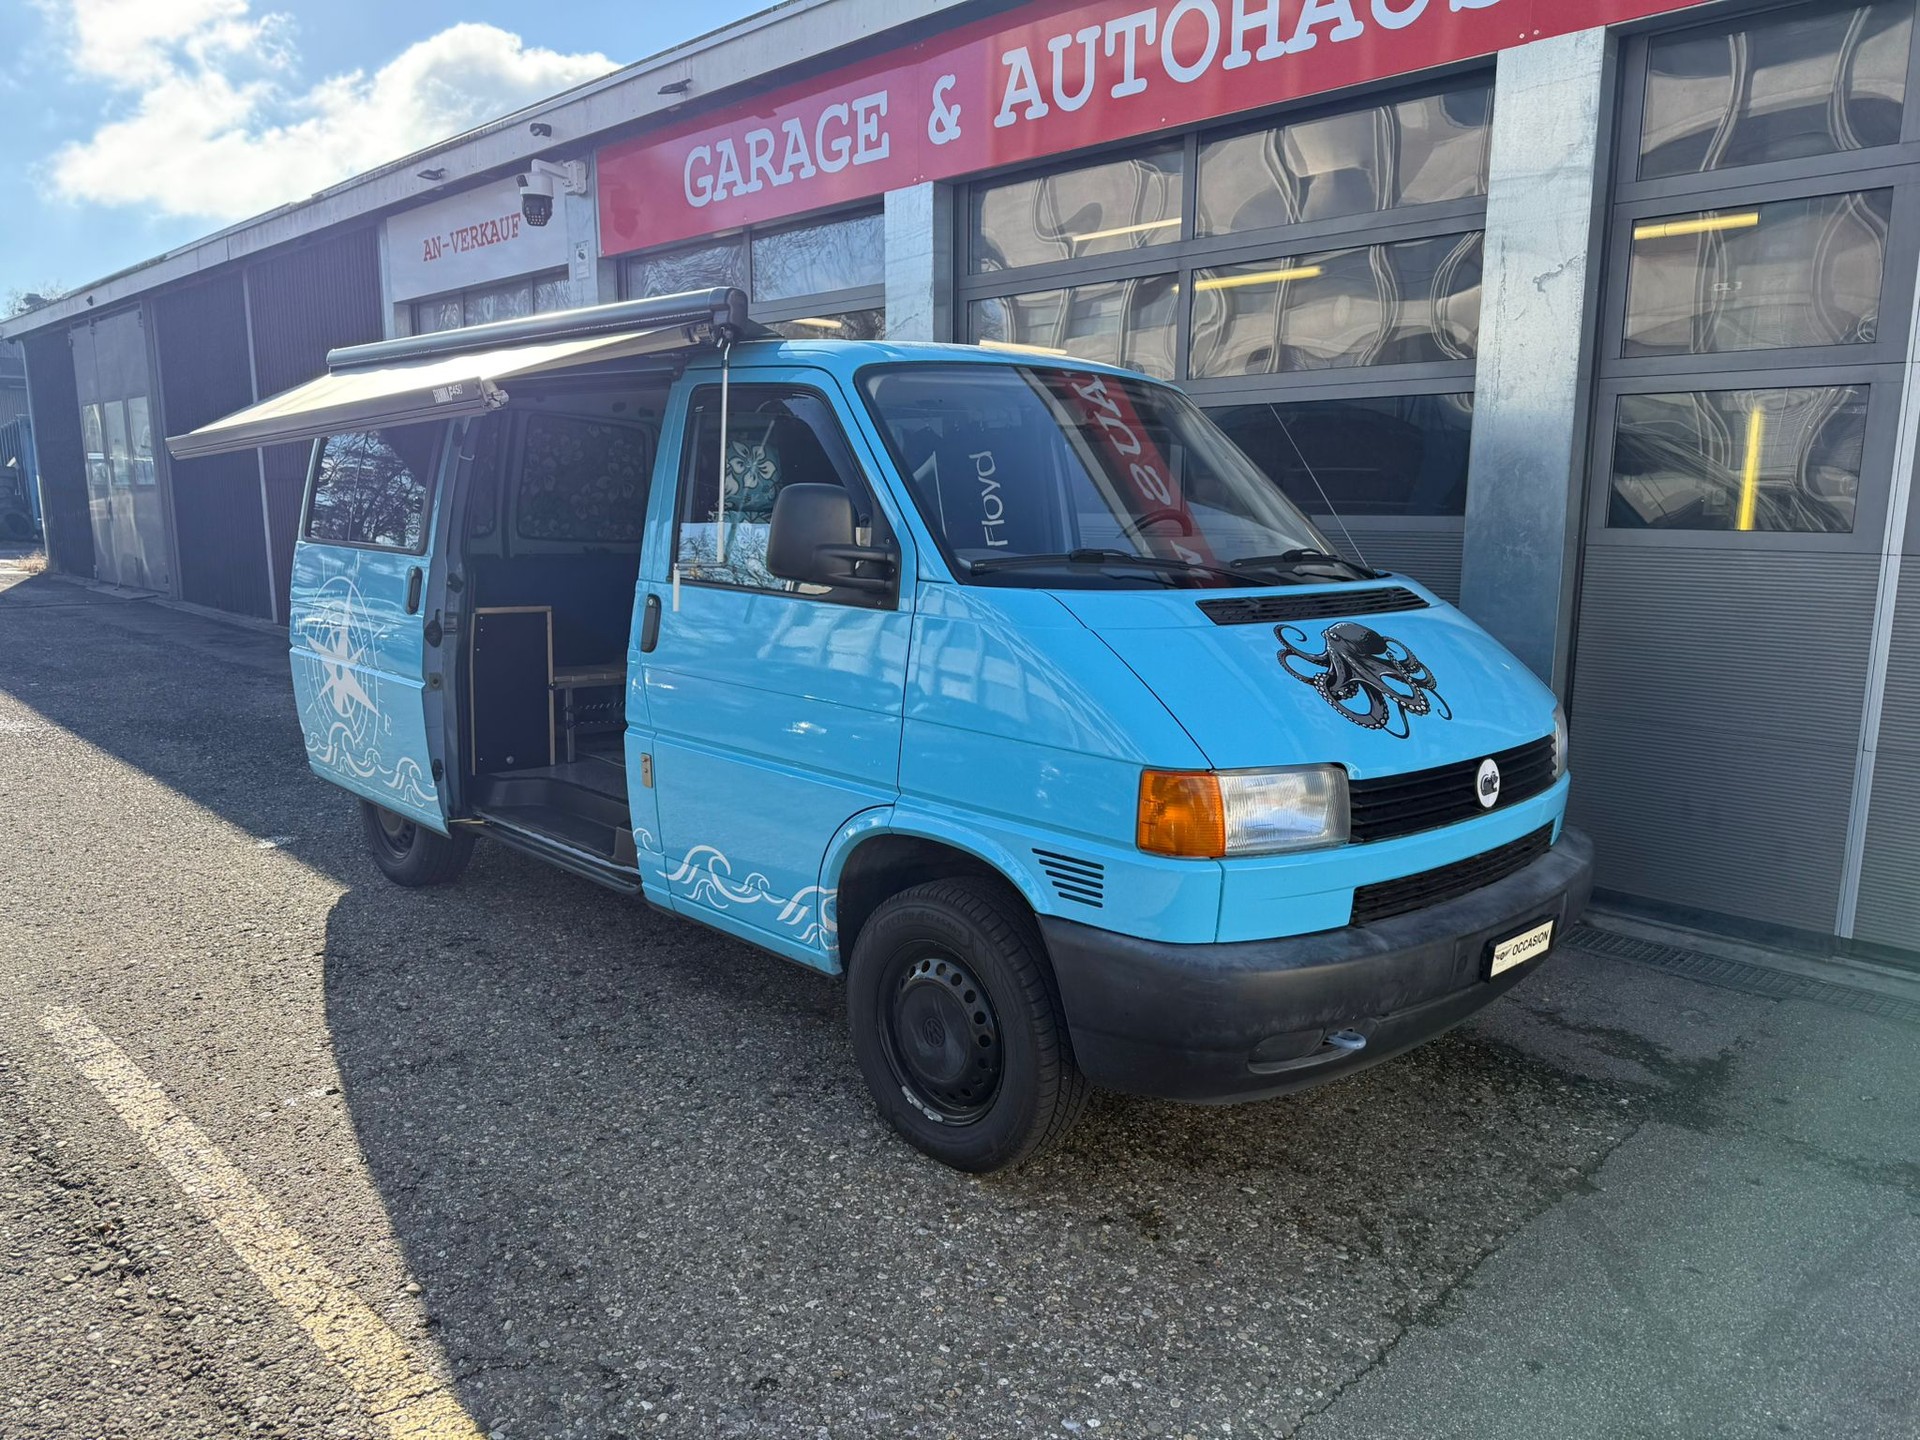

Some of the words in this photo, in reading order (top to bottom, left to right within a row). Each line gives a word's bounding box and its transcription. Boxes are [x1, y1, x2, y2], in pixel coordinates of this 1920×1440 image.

[684, 90, 889, 207] GARAGE
[928, 74, 961, 145] &
[994, 0, 1500, 127] AUTOHA
[423, 212, 521, 262] AN-VERKAUF
[968, 451, 1008, 546] Floyd
[1512, 930, 1549, 956] OCCASION
